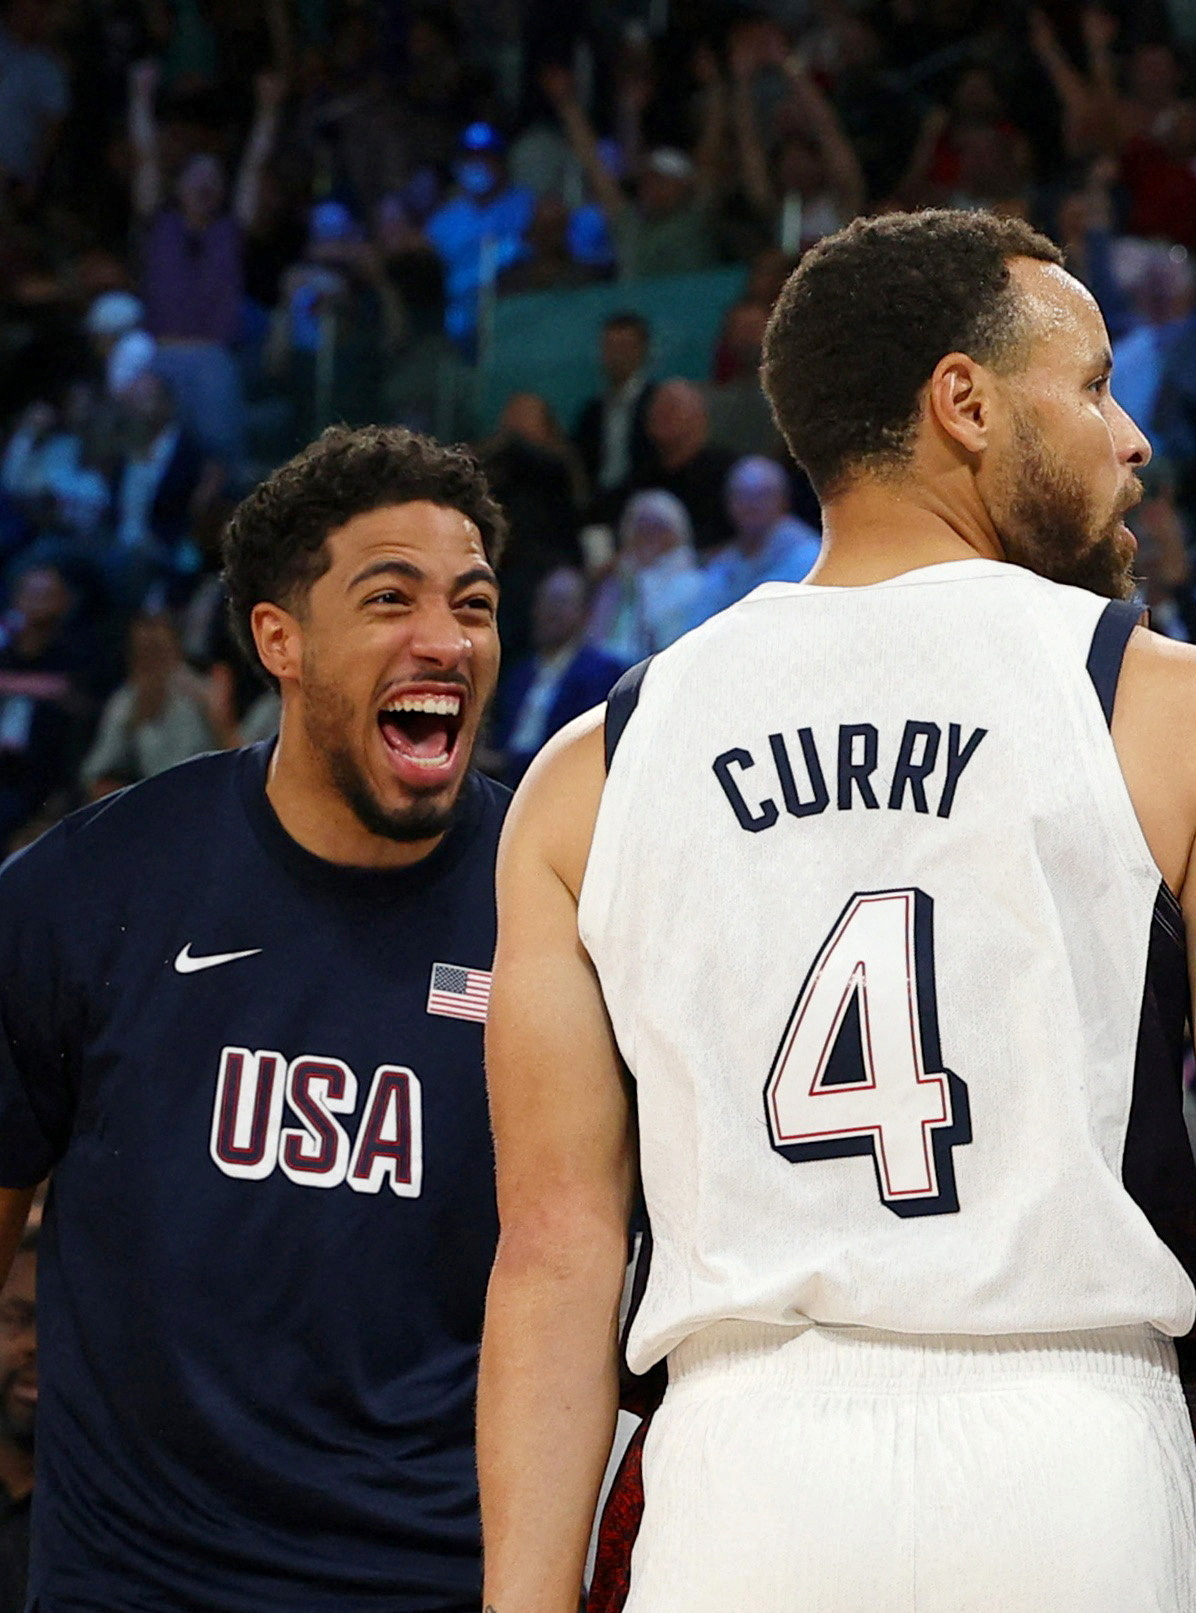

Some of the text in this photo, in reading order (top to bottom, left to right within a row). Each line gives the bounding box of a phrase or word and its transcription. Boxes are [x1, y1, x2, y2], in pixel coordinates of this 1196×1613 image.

[712, 719, 988, 833] CURRY
[210, 1046, 423, 1198] USA
[763, 887, 973, 1218] 4
